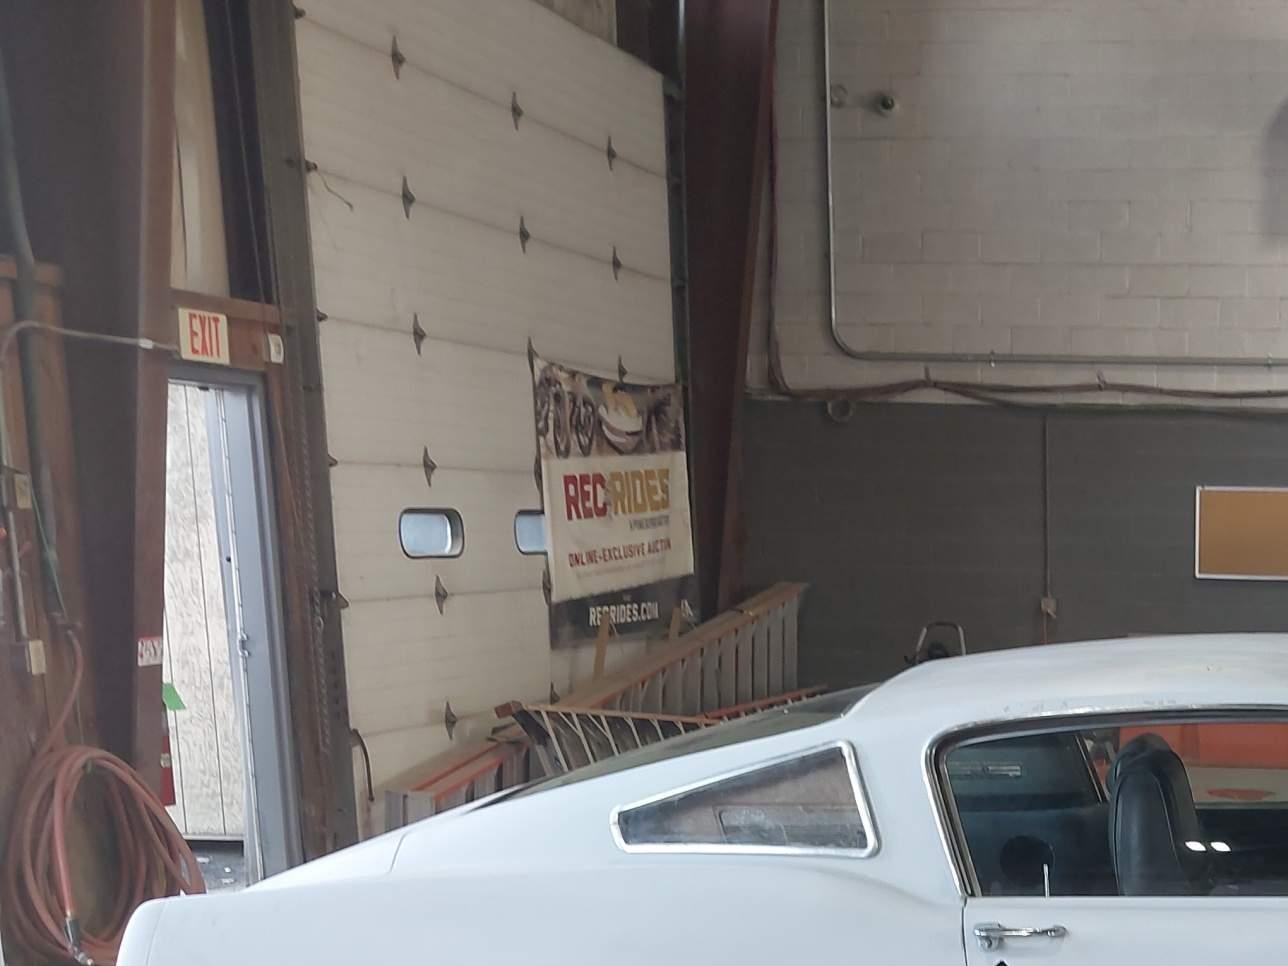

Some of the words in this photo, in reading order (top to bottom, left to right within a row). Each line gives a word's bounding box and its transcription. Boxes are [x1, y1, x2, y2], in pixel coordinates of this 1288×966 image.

[188, 312, 221, 358] EXIT
[609, 468, 671, 515] RIDES
[647, 537, 672, 554] AUCTIN
